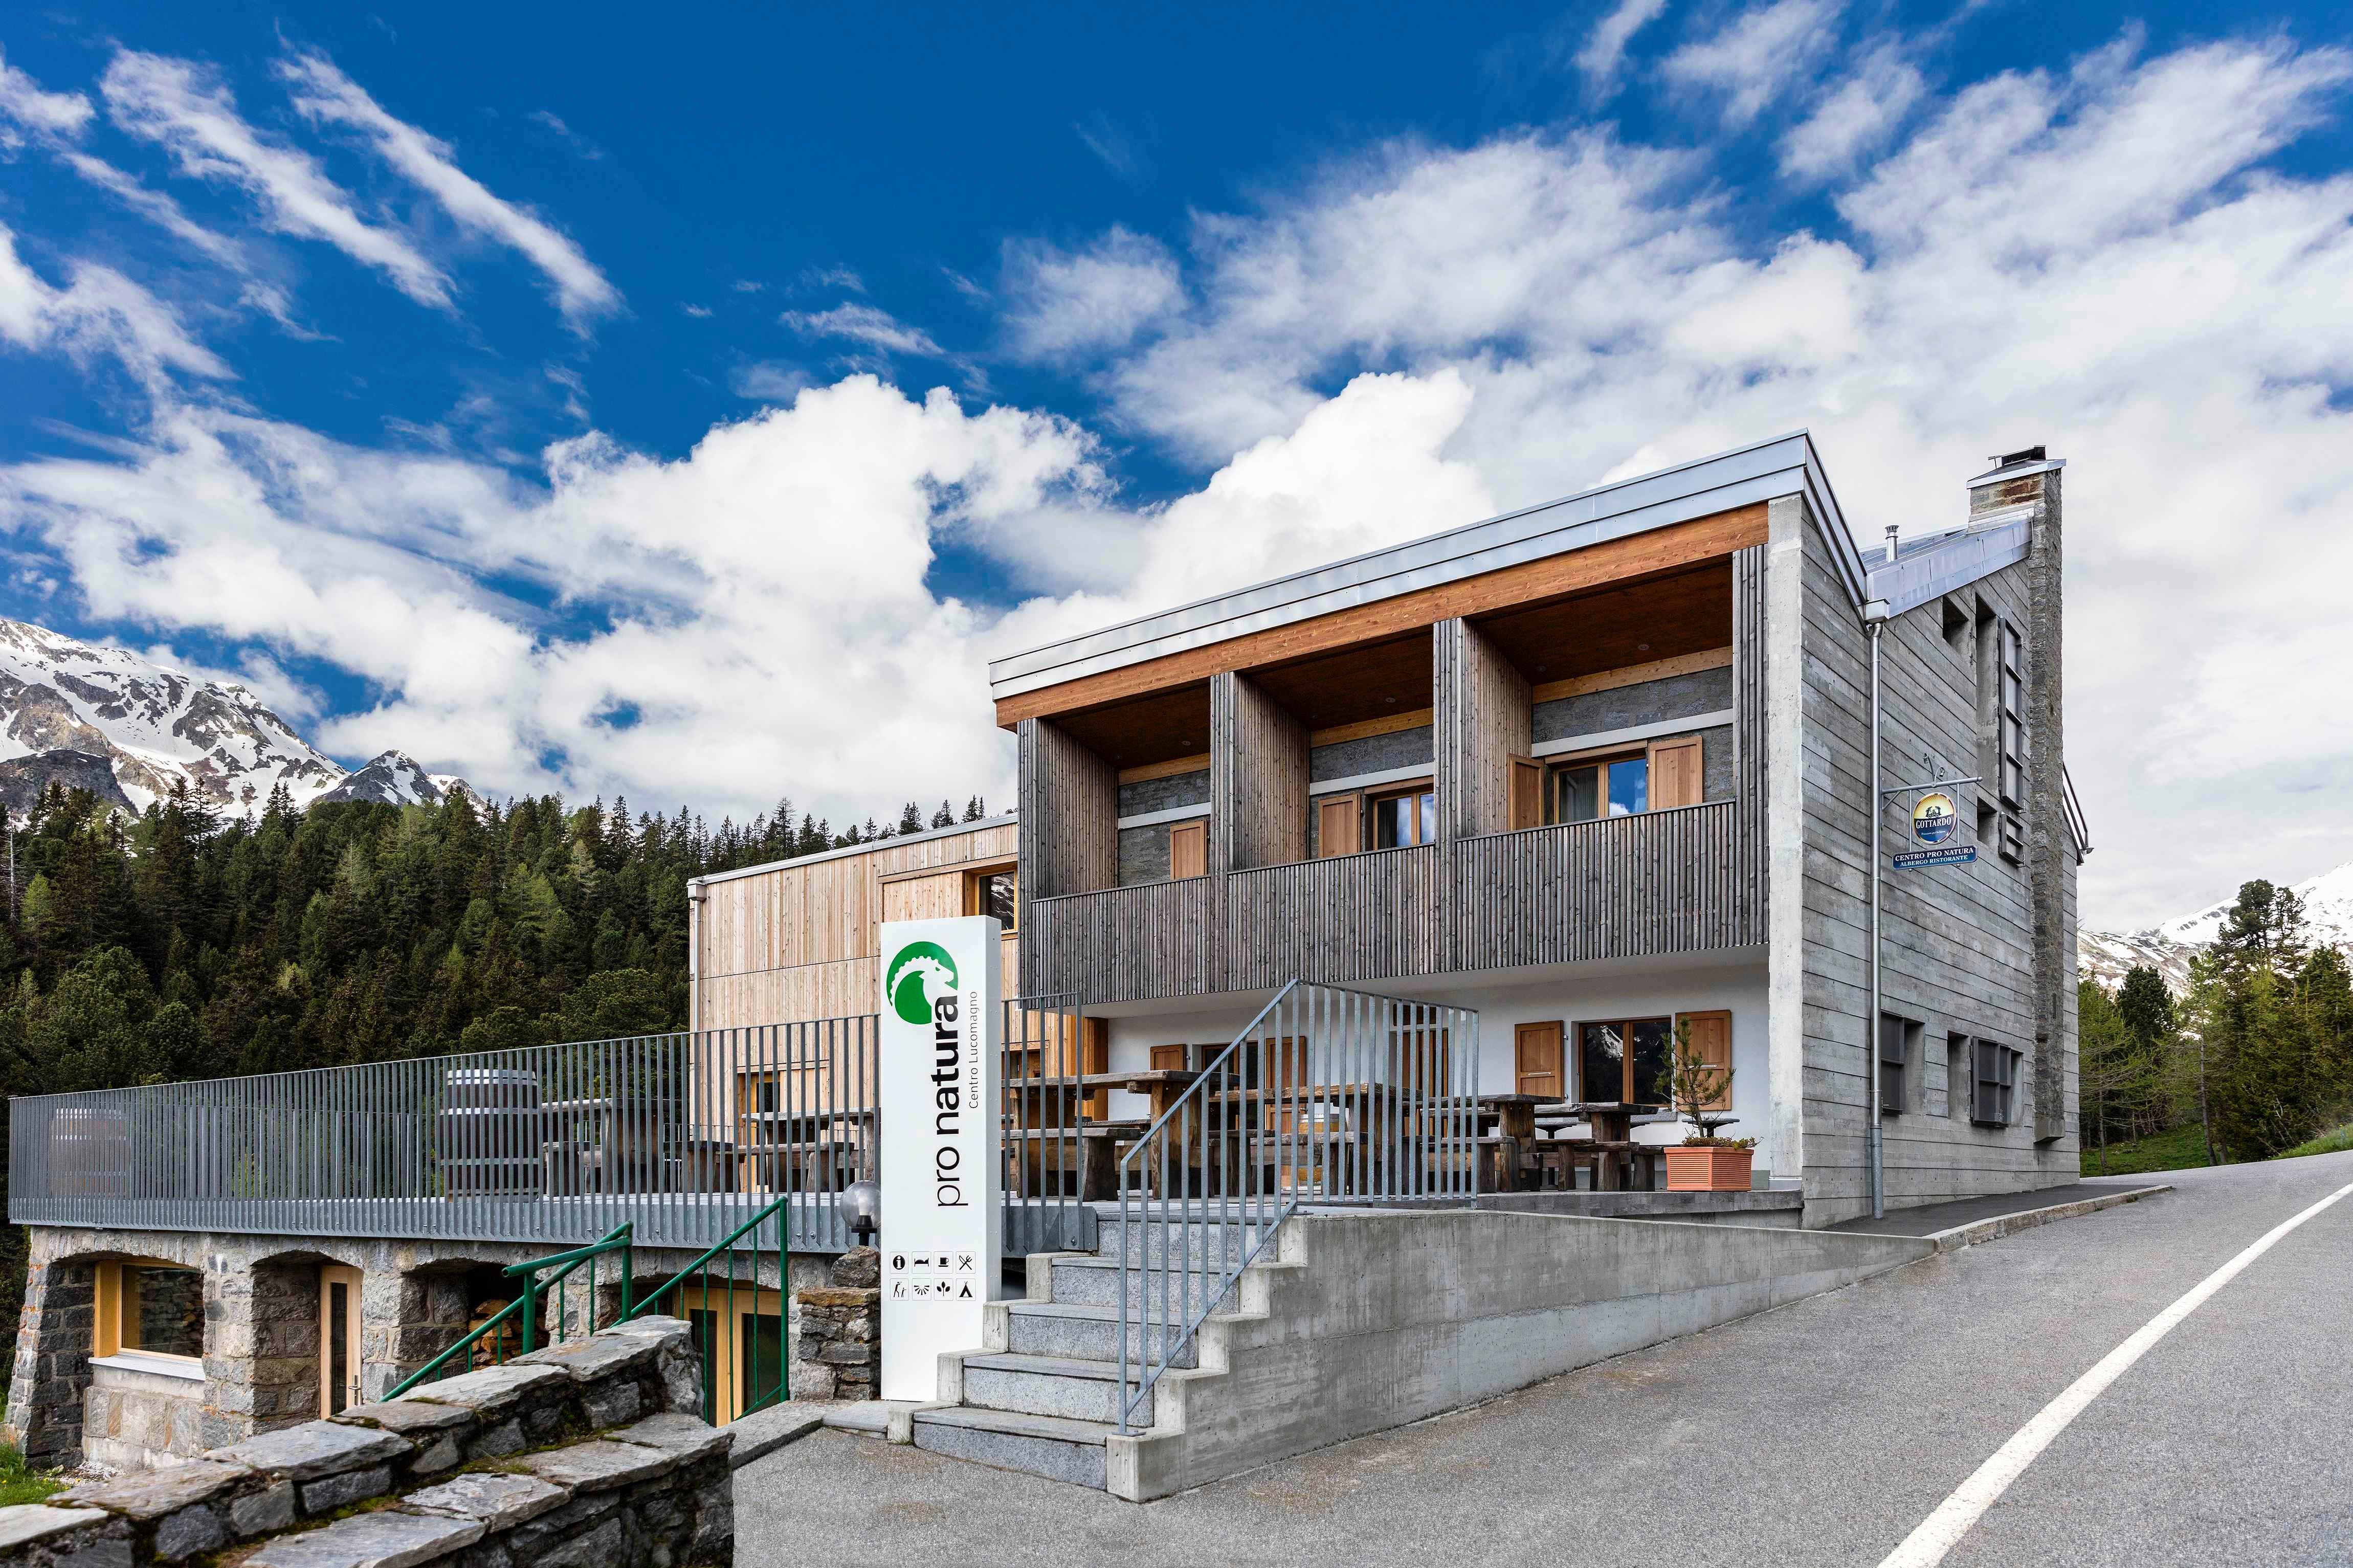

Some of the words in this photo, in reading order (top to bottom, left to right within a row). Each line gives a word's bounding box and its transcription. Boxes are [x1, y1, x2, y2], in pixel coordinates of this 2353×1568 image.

[1916, 817, 1951, 829] GOTTARDO
[1895, 853, 1924, 861] CENTRO
[1944, 847, 1973, 856] NATURA
[1929, 855, 1968, 864] RISTORANTE
[969, 991, 980, 1063] Lucomagno
[930, 995, 960, 1135] natura
[969, 1068, 979, 1109] Centro
[937, 1147, 968, 1207] pro
